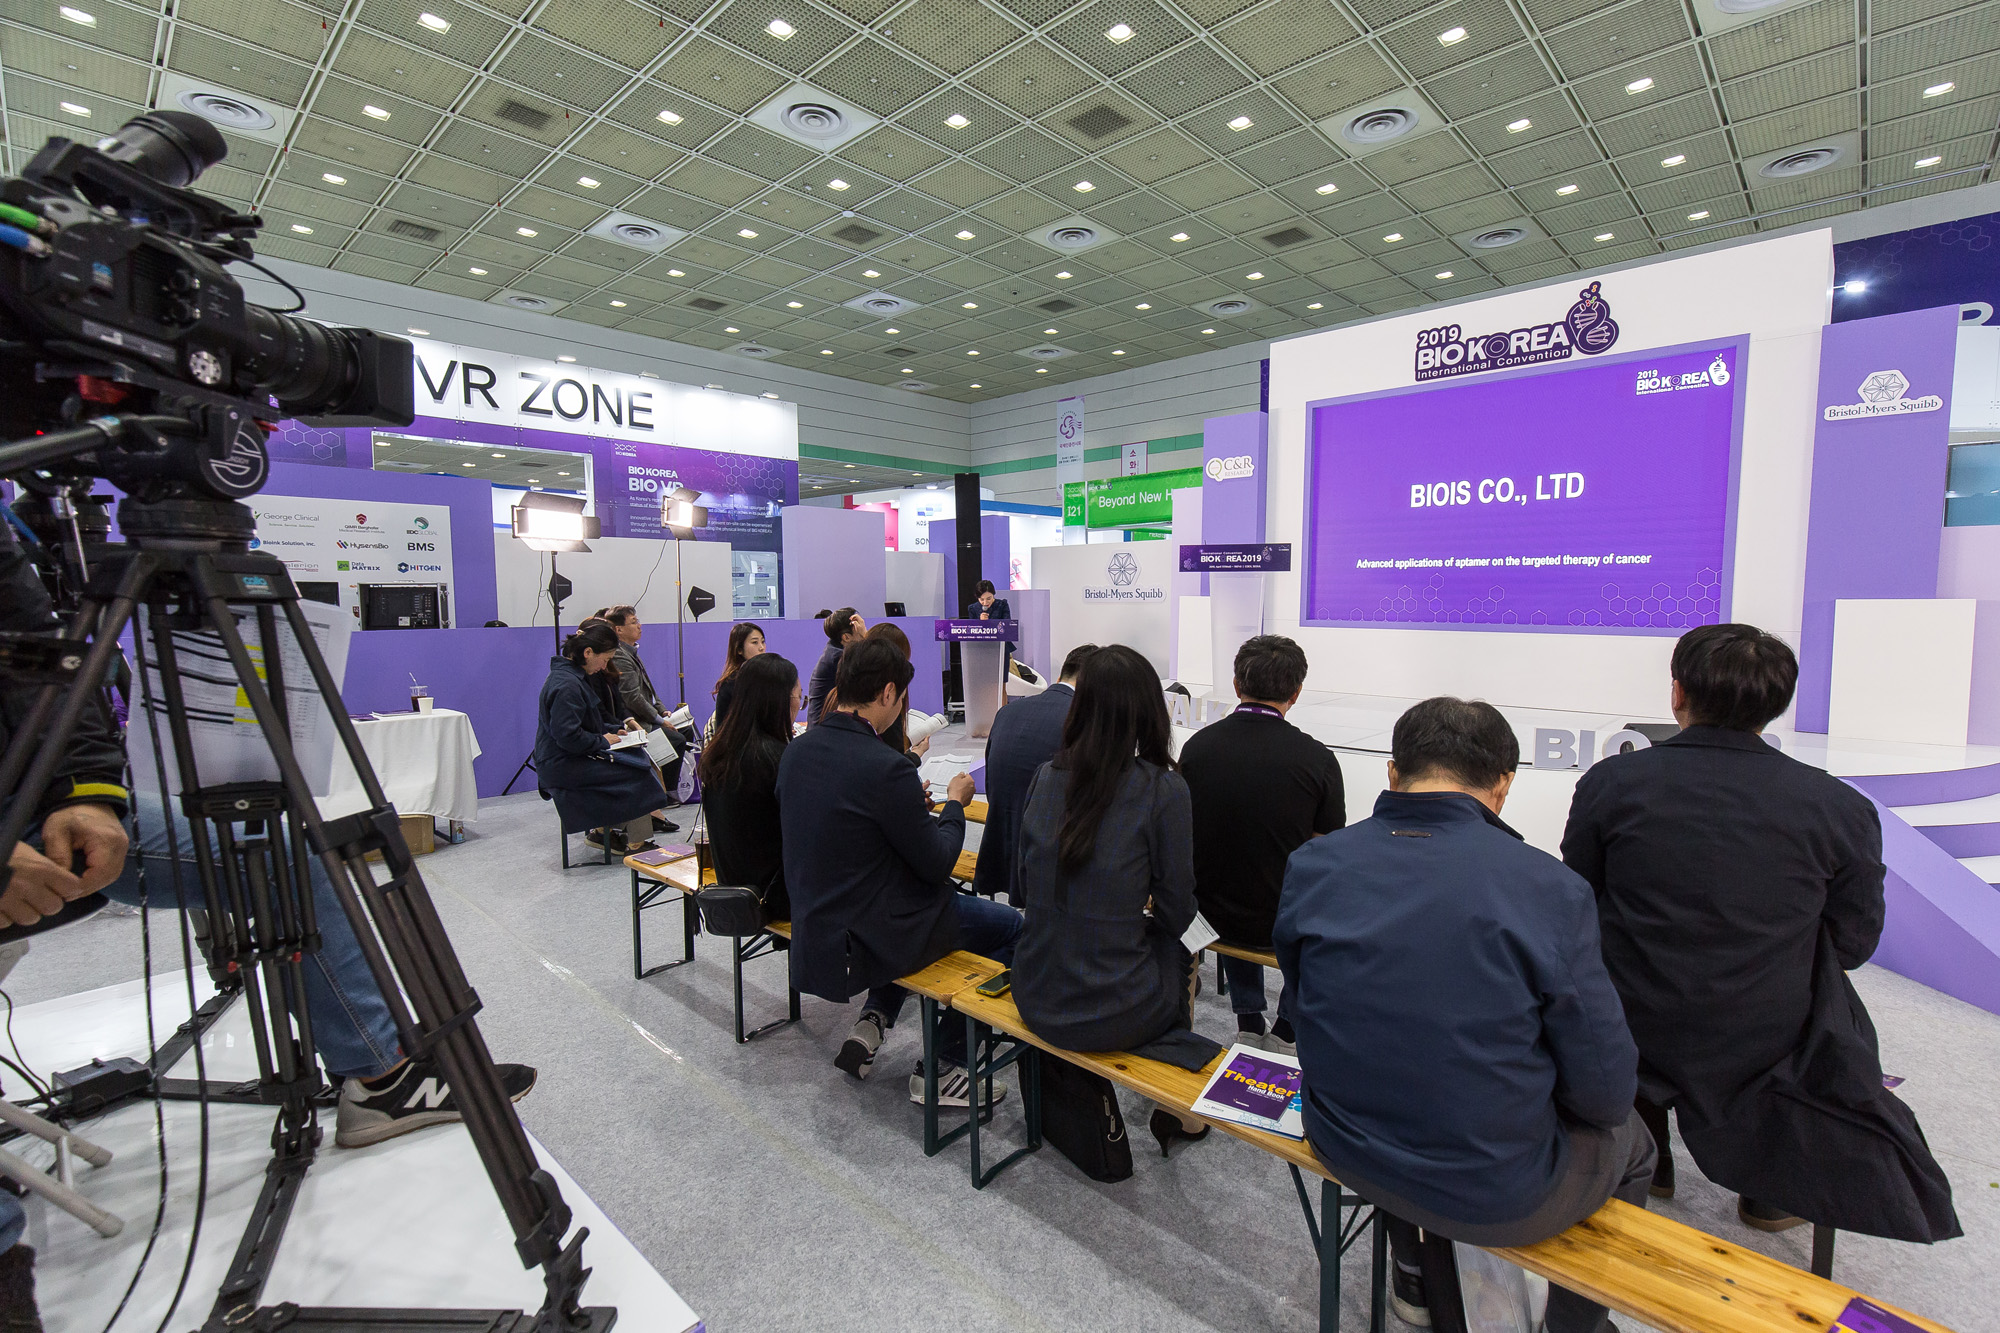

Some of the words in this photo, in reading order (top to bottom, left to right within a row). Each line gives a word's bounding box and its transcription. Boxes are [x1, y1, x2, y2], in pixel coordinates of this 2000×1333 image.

[1418, 326, 1459, 348] 2019
[1417, 344, 1464, 370] BIO
[1468, 324, 1570, 362] KOREA
[1417, 360, 1492, 380] International
[1496, 348, 1570, 366] Convention
[1636, 378, 1660, 390] BIO
[1660, 371, 1710, 388] KOREA
[1637, 369, 1658, 380] 2019
[414, 354, 500, 410] VR
[518, 371, 654, 430] ZONE
[1636, 386, 1674, 396] International
[1674, 382, 1710, 390] Convention
[1828, 404, 1896, 418] Bristol-Myers
[1900, 400, 1938, 412] Squibb
[628, 466, 645, 476] BIO
[646, 468, 678, 478] KOREA
[1224, 458, 1252, 470] C&R
[628, 478, 658, 492] BIO
[1410, 480, 1472, 508] BIOIS
[1478, 477, 1528, 506] CO.,
[1535, 472, 1585, 500] LTD
[1099, 492, 1136, 508] Beyond
[1140, 492, 1162, 504] New
[264, 512, 292, 522] George
[294, 514, 320, 522] Clinical
[1068, 506, 1081, 516] I21
[408, 542, 435, 551] BMS
[1356, 558, 1394, 568] Advanced
[1395, 558, 1443, 570] applications
[1444, 557, 1454, 567] of
[1455, 558, 1490, 568] aptamer
[1491, 558, 1504, 566] on
[1505, 556, 1520, 566] the
[1522, 554, 1561, 568] targeted
[1563, 554, 1601, 567] therapy
[1602, 553, 1615, 564] of
[1615, 554, 1652, 564] cancer
[1085, 588, 1133, 600] Bristol-Myers
[1135, 588, 1163, 600] Squibb
[1224, 1069, 1296, 1097] Theater
[404, 1077, 451, 1108] N
[1247, 1085, 1267, 1094] Hand
[1266, 1090, 1285, 1100] Book
